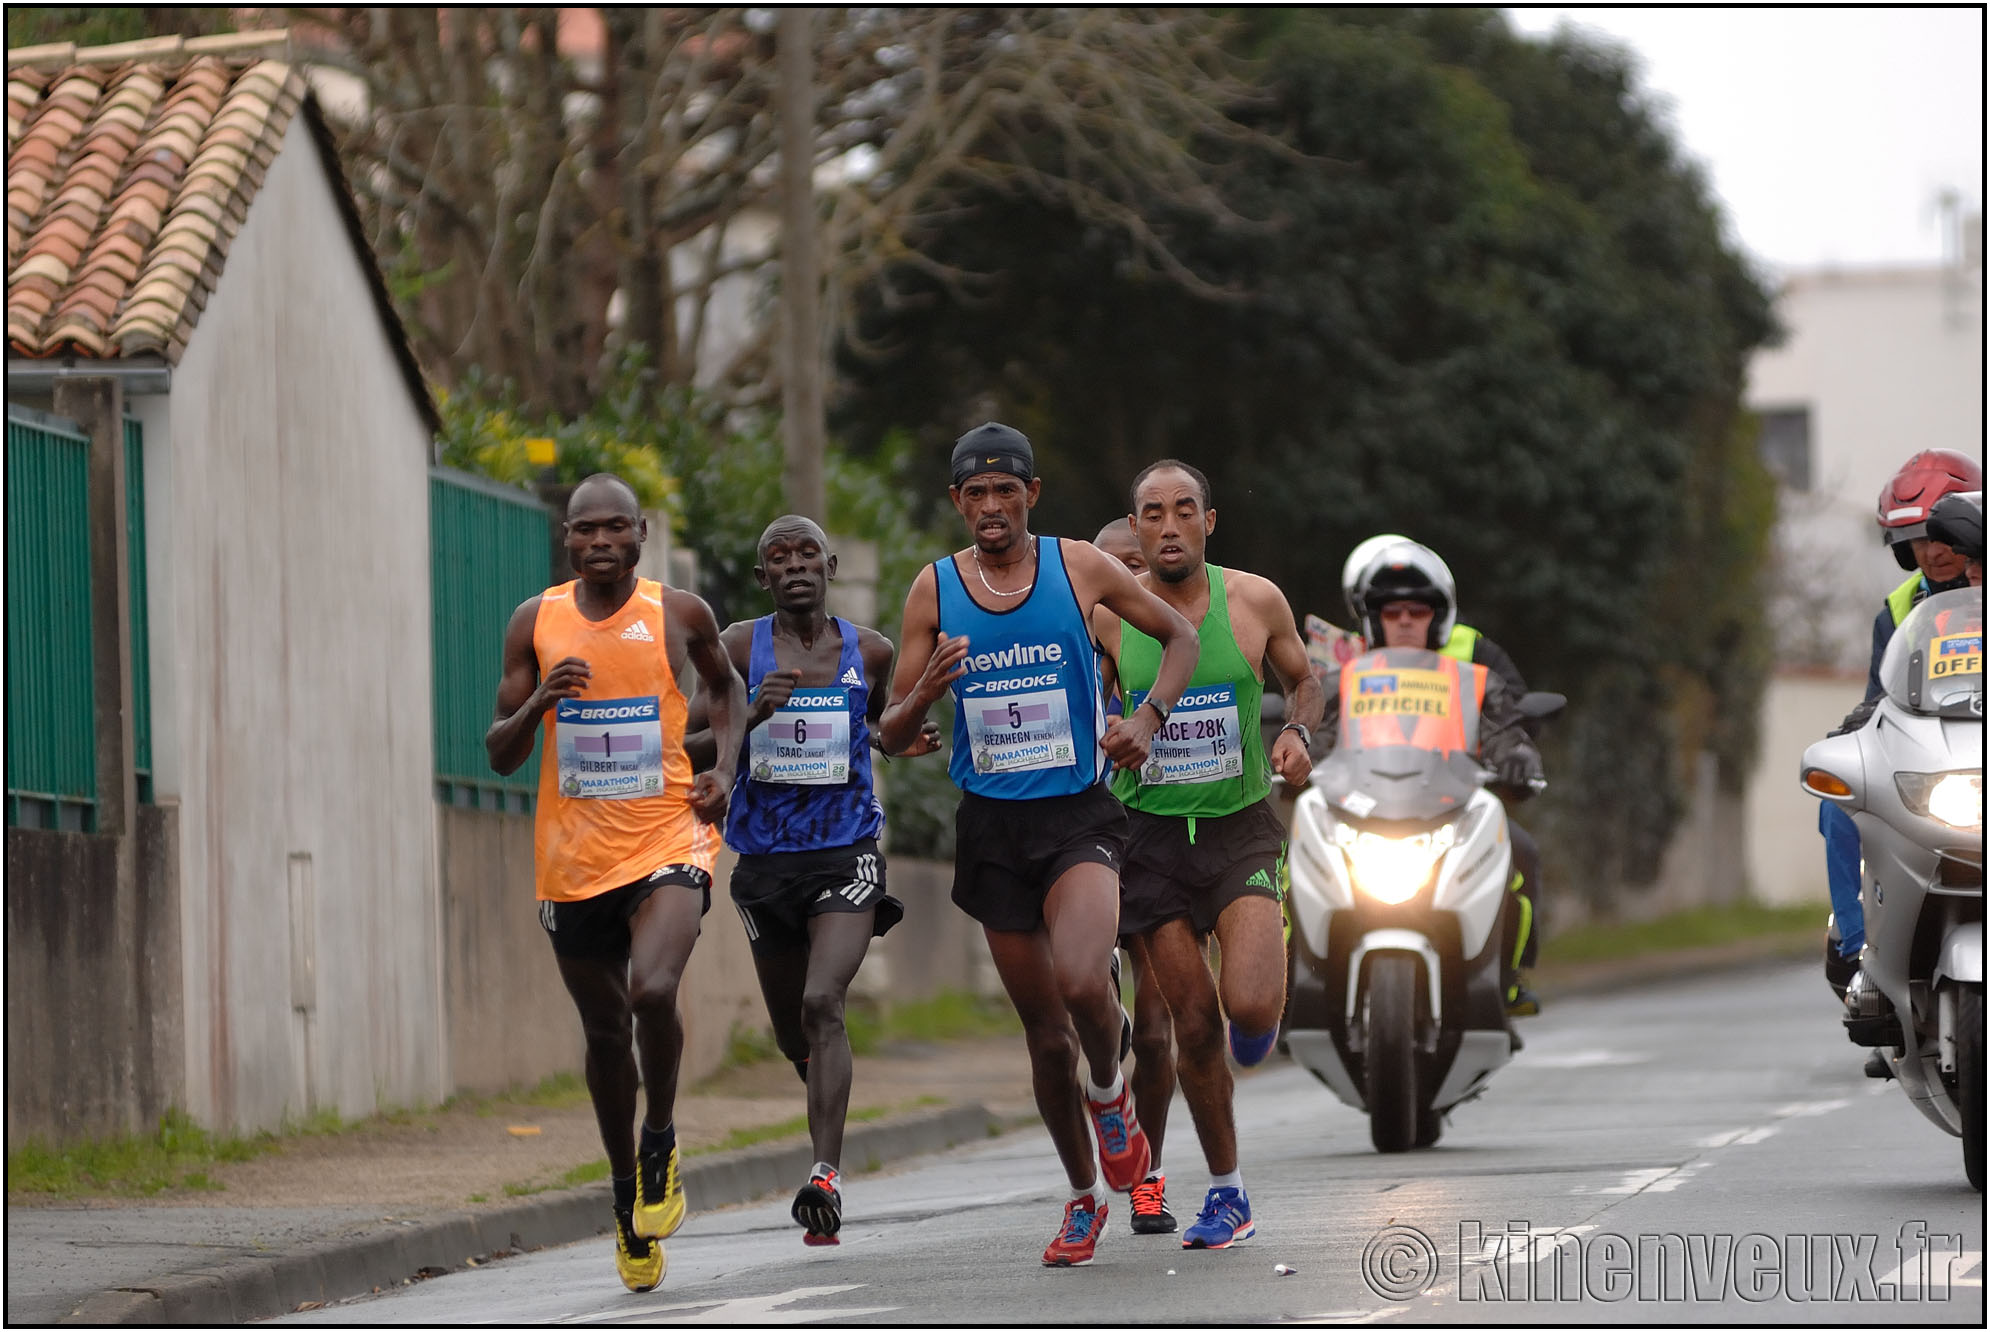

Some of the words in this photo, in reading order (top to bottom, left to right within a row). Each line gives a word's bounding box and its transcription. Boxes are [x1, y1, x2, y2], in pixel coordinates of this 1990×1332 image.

[620, 632, 655, 642] adidas
[960, 643, 1062, 675] newline
[985, 673, 1060, 692] BROOKS
[785, 696, 845, 707] ROOKS
[1354, 697, 1447, 717] OFFICIEL
[580, 704, 655, 720] BROOKS
[1008, 702, 1022, 729] 5
[794, 718, 807, 745] 6
[1195, 717, 1227, 740] 28K
[601, 731, 611, 758] 1
[984, 731, 1031, 746] GEZAHEGN
[776, 746, 802, 758] ISAAC
[804, 751, 826, 759] LANGAT
[993, 744, 1049, 761] MARATHON
[1055, 746, 1069, 756] 29
[1155, 747, 1191, 759] ETHIOPIE
[1211, 739, 1227, 757] 15
[580, 761, 618, 773] GILBERT
[773, 762, 827, 772] MARATHON
[1164, 758, 1219, 773] MARATHON
[1225, 758, 1238, 768] 29
[581, 775, 639, 788] MARATHON
[645, 778, 659, 787] 29
[1246, 879, 1275, 891] adidas
